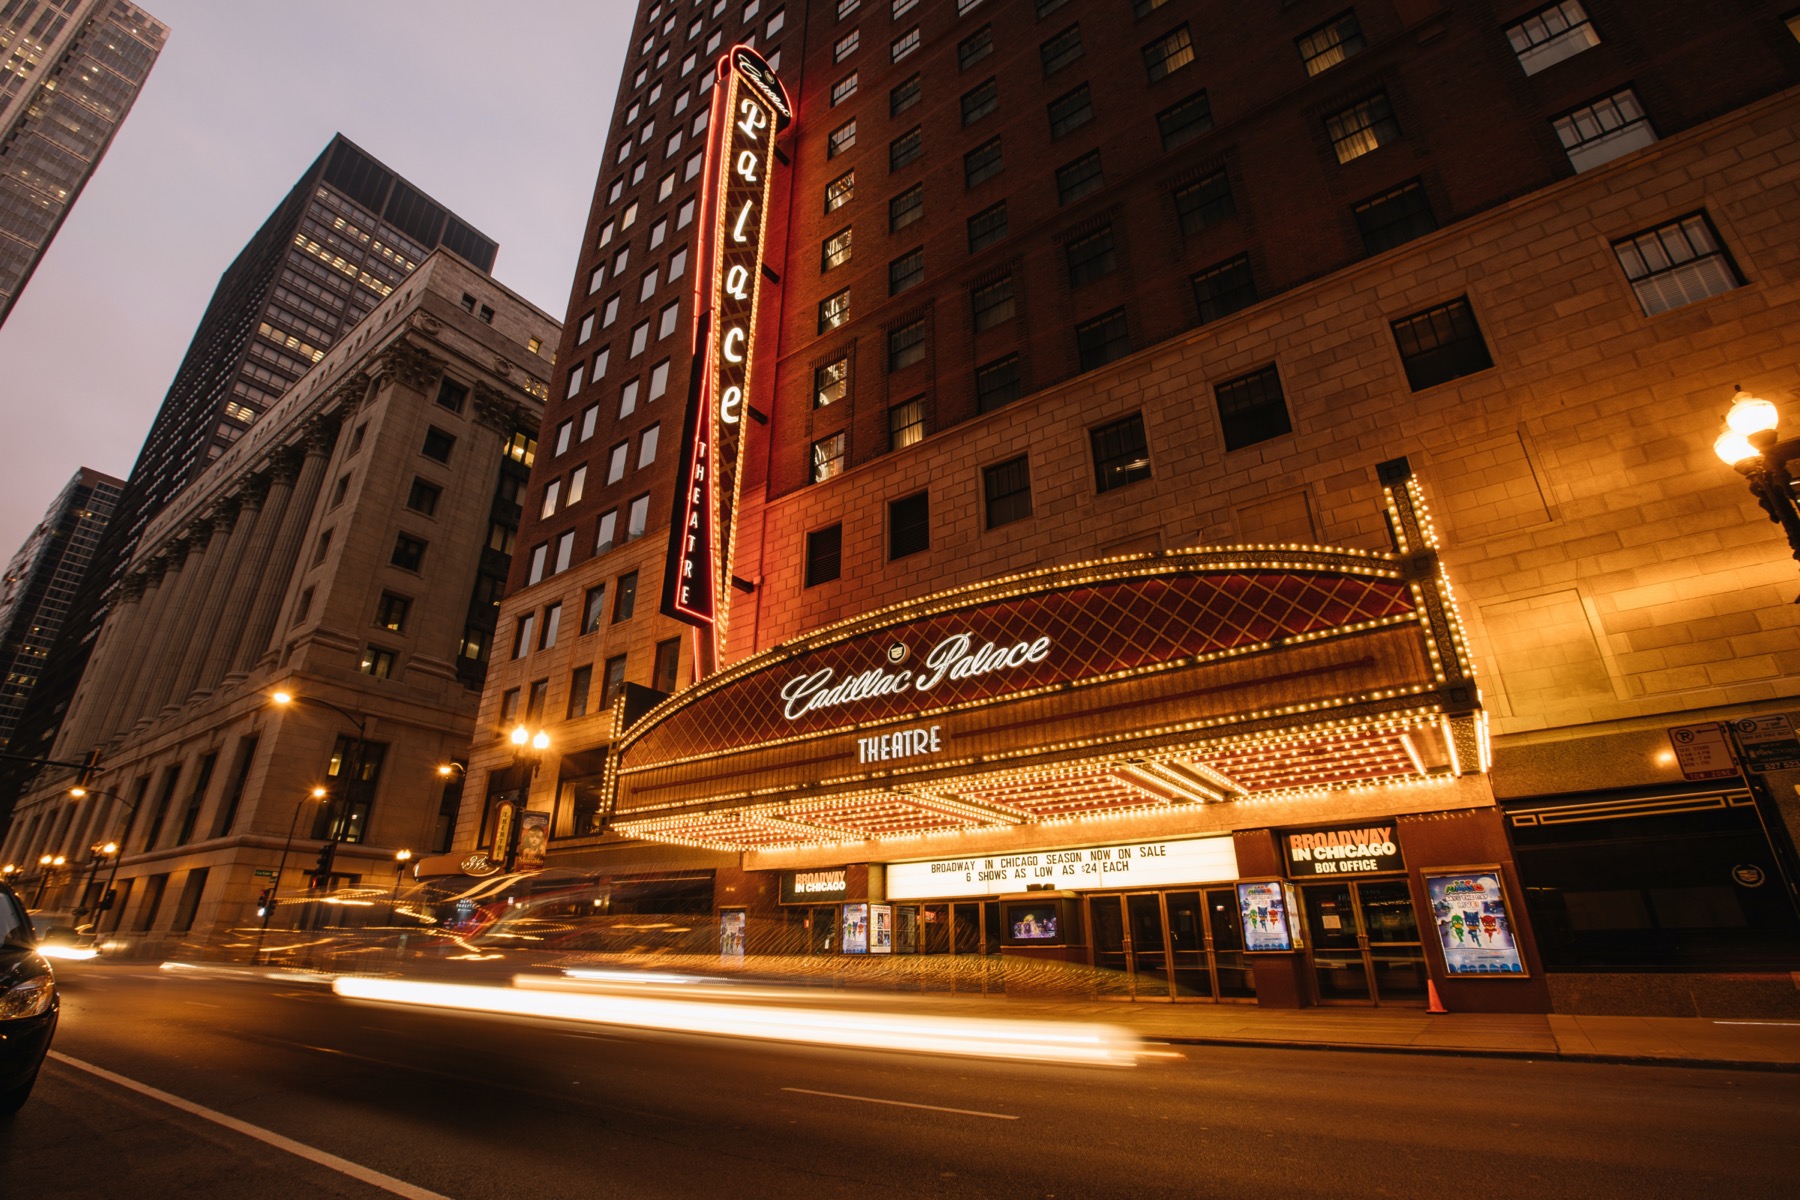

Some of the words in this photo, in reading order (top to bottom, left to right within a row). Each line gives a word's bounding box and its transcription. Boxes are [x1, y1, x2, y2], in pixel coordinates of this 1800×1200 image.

[738, 54, 791, 117] Cadillac
[720, 98, 766, 424] Palace
[680, 441, 708, 606] THEATRE
[780, 666, 912, 721] Cadillac
[915, 631, 1051, 692] Palace
[857, 725, 943, 764] THEATRE
[1289, 827, 1392, 850] BROADWAY
[1291, 847, 1312, 862] IN
[1313, 841, 1397, 861] CHICAGO
[931, 861, 976, 874] BROADWAY
[1000, 856, 1038, 869] CHICAGO
[1046, 852, 1082, 866] SEASON
[1090, 849, 1112, 862] NOW
[1118, 848, 1132, 860] ON
[1139, 845, 1167, 858] SALE
[966, 872, 972, 882] 6
[978, 870, 1007, 882] SHOWS
[1014, 868, 1027, 879] AS
[1034, 866, 1053, 878] LOW
[1062, 864, 1075, 876] AS
[1081, 863, 1097, 874] $24
[1102, 861, 1129, 873] EACH
[1314, 861, 1338, 874] BOX
[1339, 859, 1378, 872] OFFICE
[795, 871, 846, 885] BROADWAY
[795, 883, 805, 893] IN
[805, 881, 846, 892] CHICAGO
